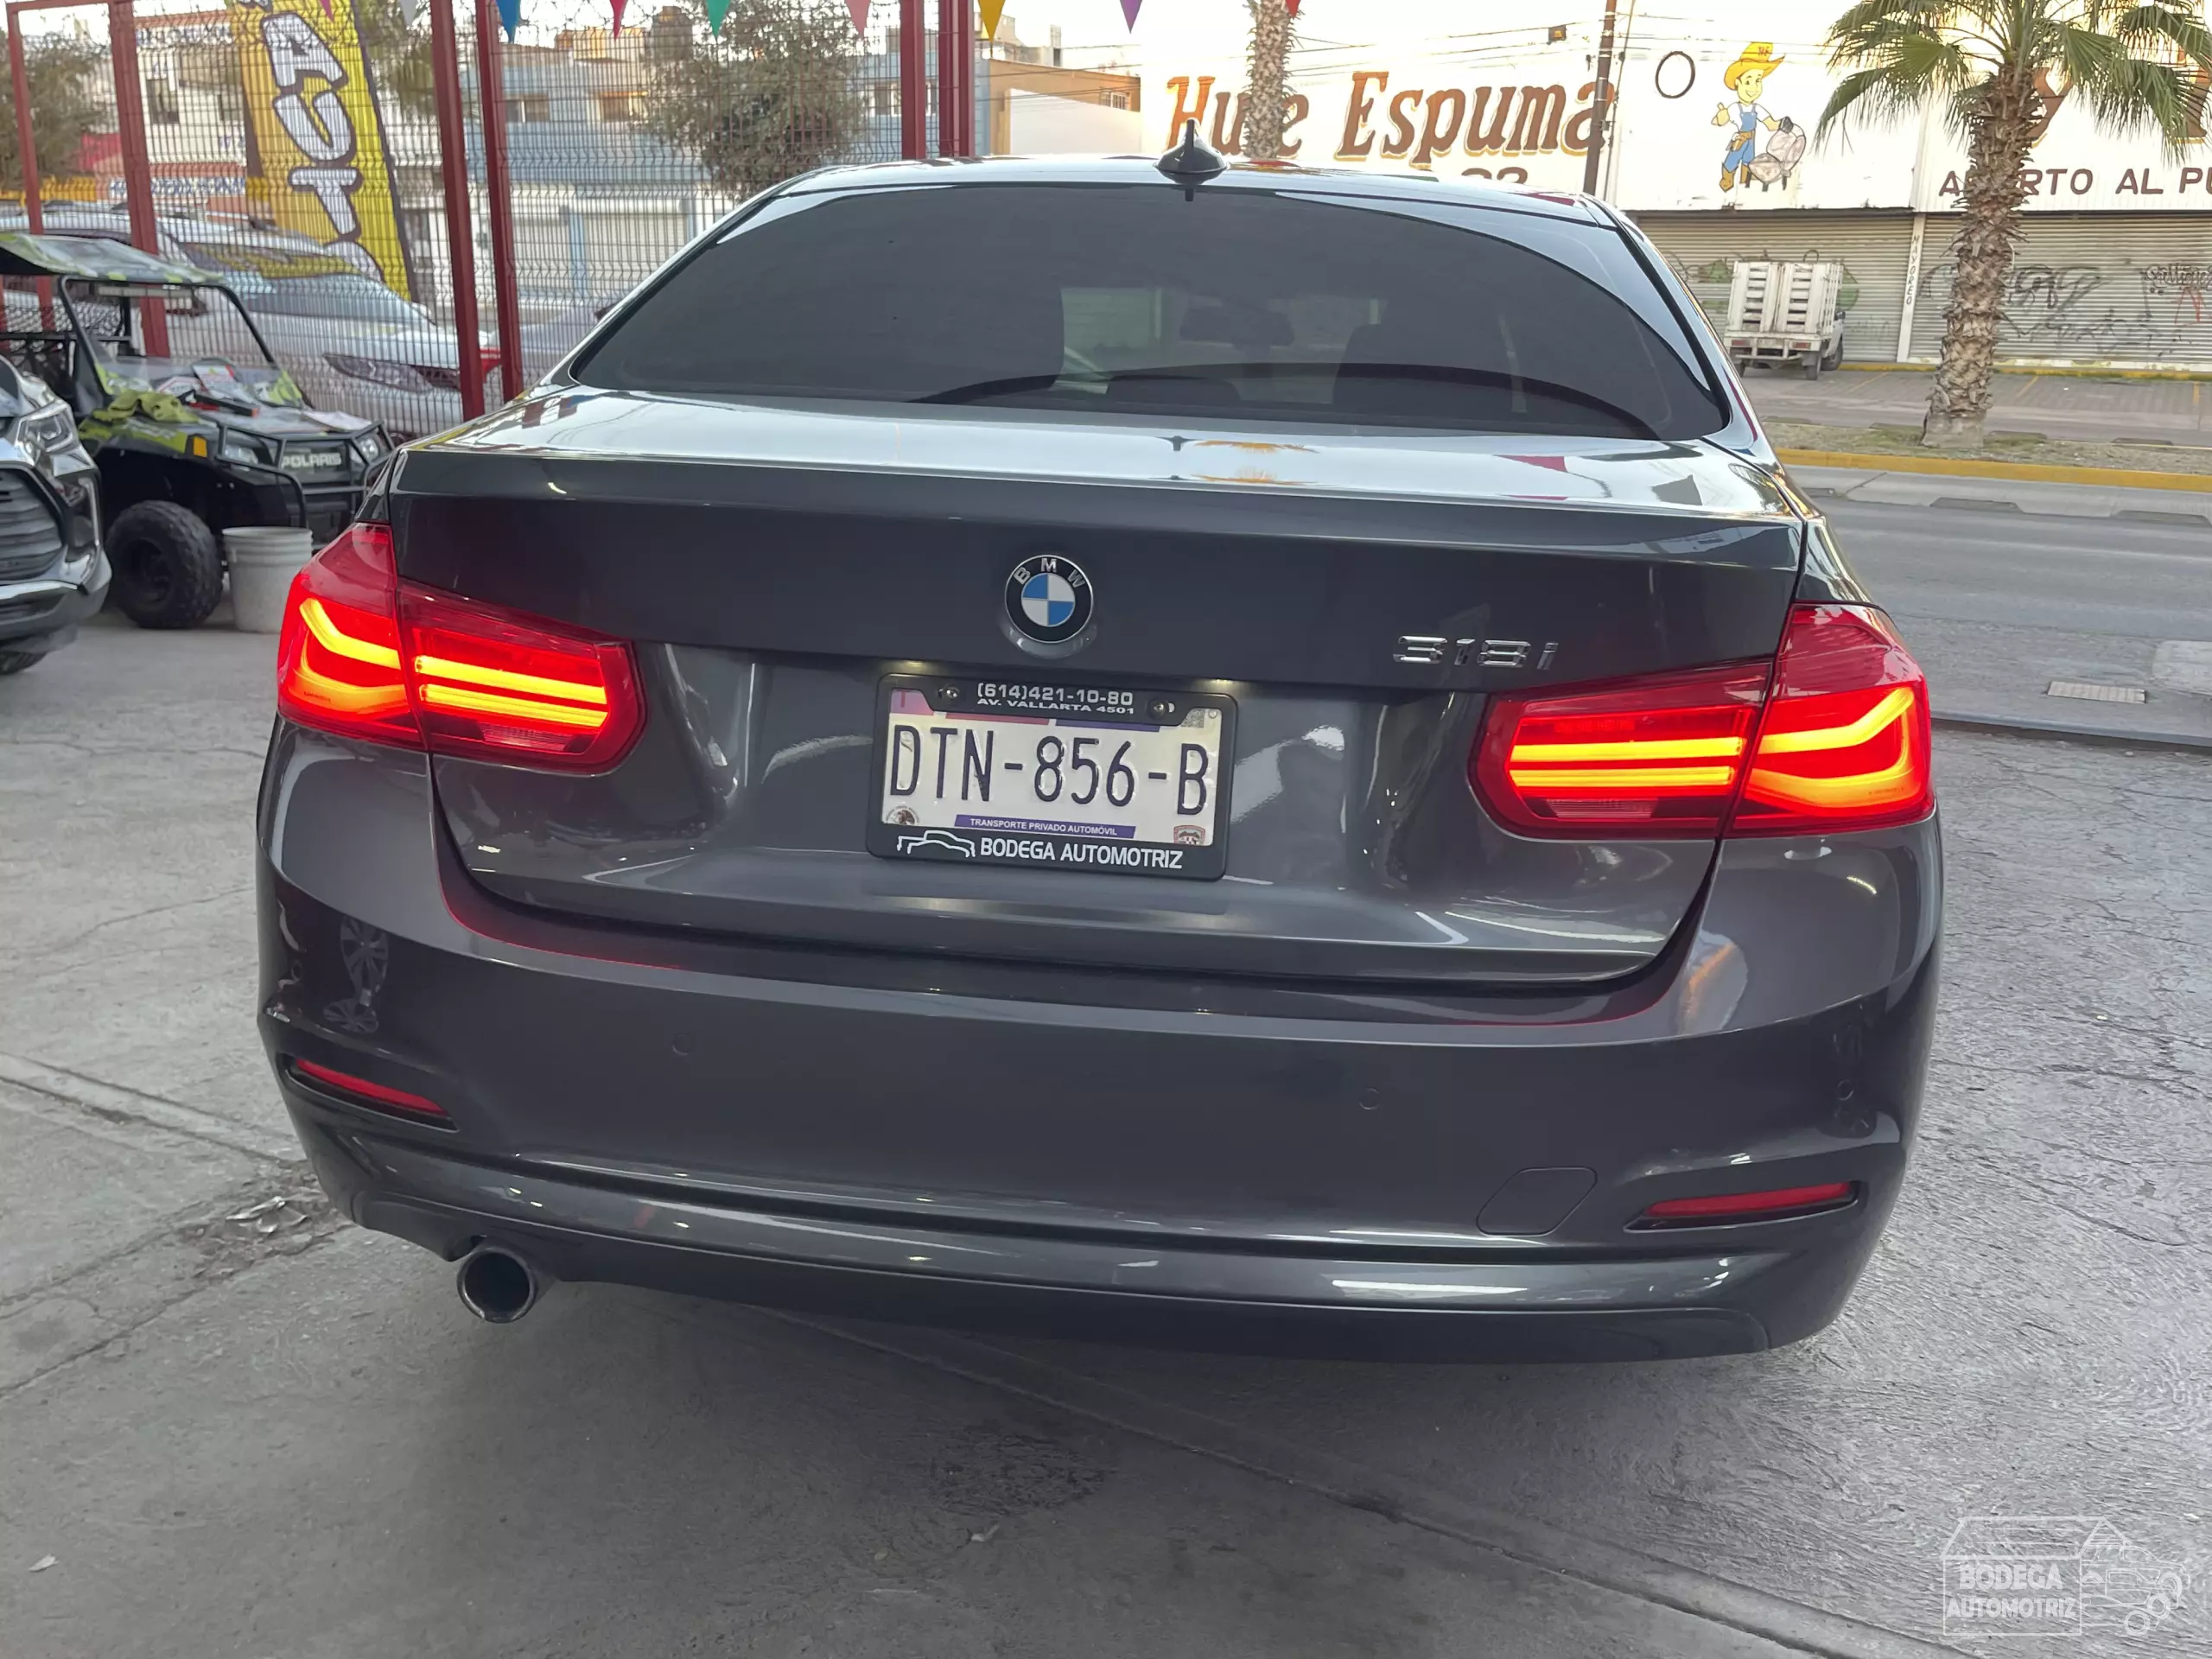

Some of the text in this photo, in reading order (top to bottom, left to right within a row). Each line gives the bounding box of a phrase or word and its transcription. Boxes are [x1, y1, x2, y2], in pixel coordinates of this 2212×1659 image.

[1166, 71, 1614, 169] Hue Espuma
[1939, 168, 2094, 197] ARTO
[2116, 168, 2164, 195] AL
[1905, 234, 1920, 306] MAYOREO
[281, 452, 342, 469] POLARIS
[1014, 557, 1085, 589] BMW
[1393, 635, 1559, 671] 318i
[977, 682, 1134, 706] (614)421-10-80
[977, 698, 1135, 715] AV. VALLARTA 4501
[889, 724, 1210, 816] DTN-856-B
[969, 817, 1118, 836] TRANSPORTE PRIVADO AUTOMÓVIL
[980, 837, 1183, 869] BODEGA AUTOMOTRIZ
